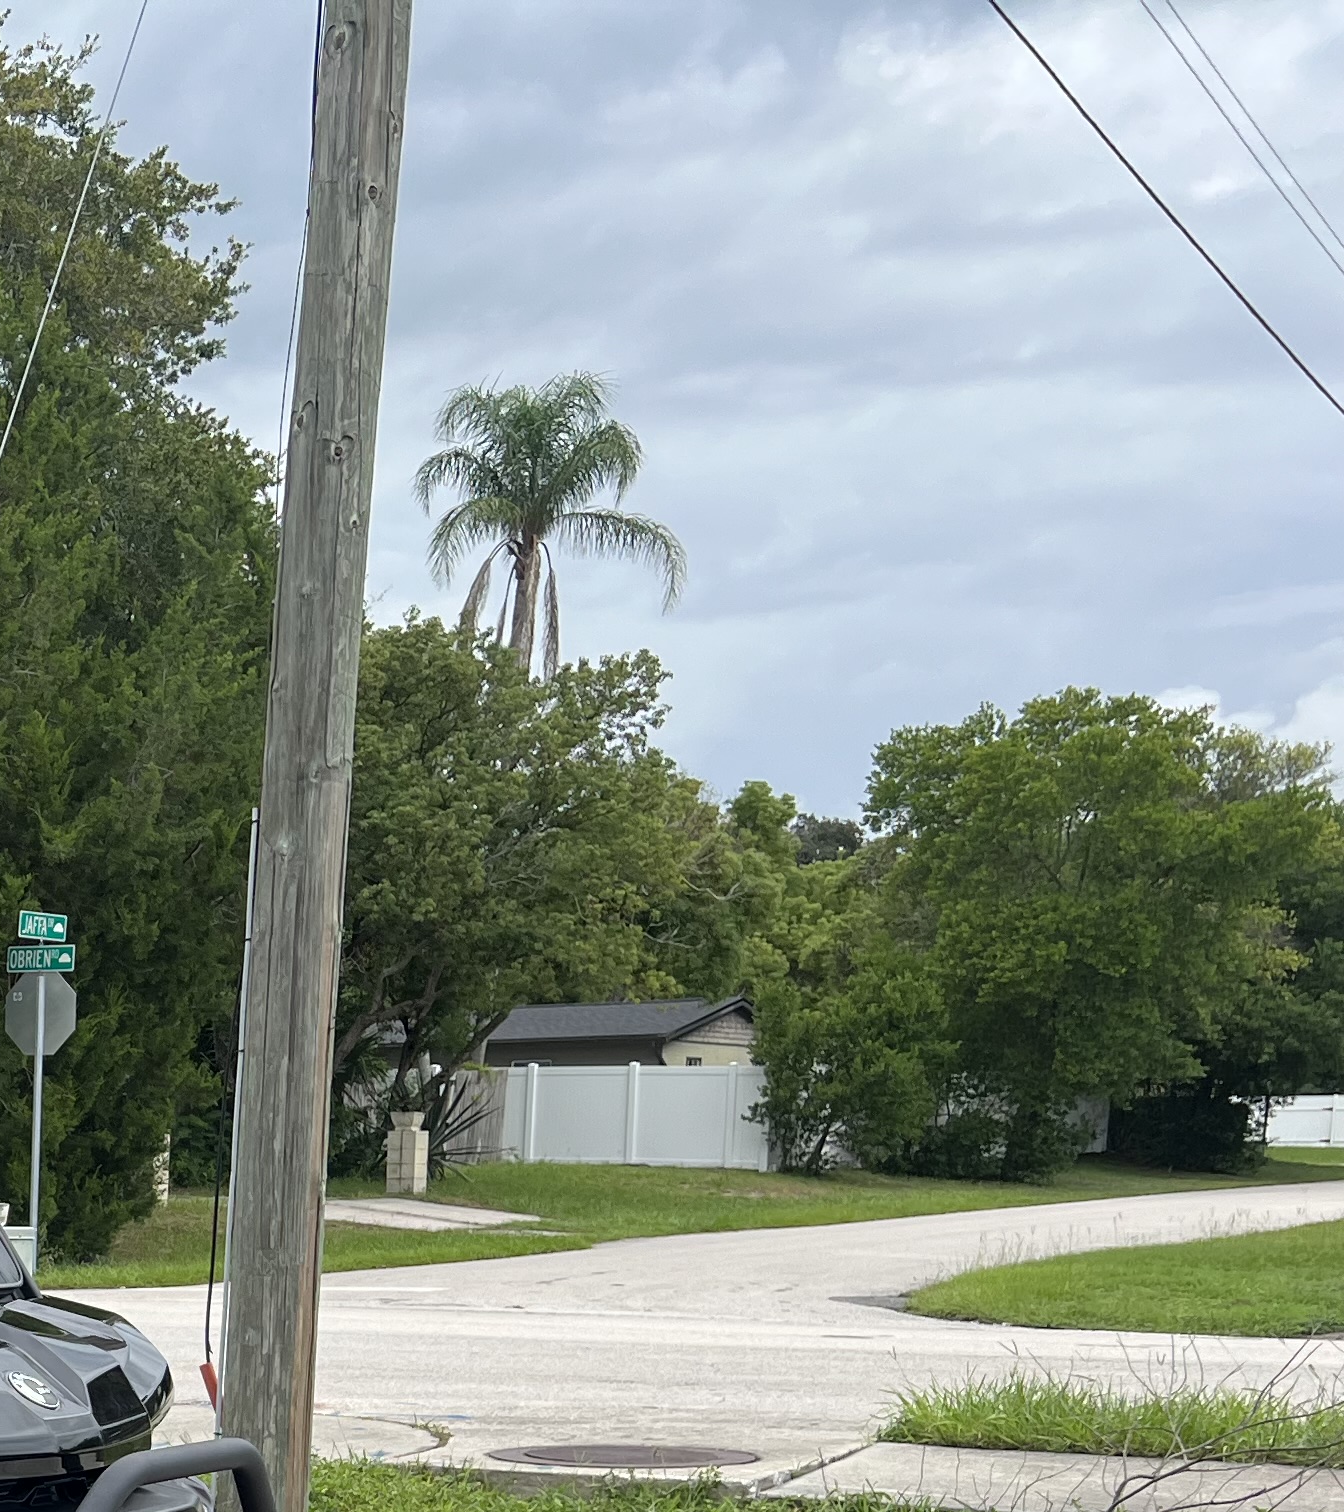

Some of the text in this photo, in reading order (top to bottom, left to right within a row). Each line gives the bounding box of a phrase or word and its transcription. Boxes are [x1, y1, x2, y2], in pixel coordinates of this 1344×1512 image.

[21, 915, 55, 936] JAFFA DR
[9, 948, 60, 969] OBRIEN RD
